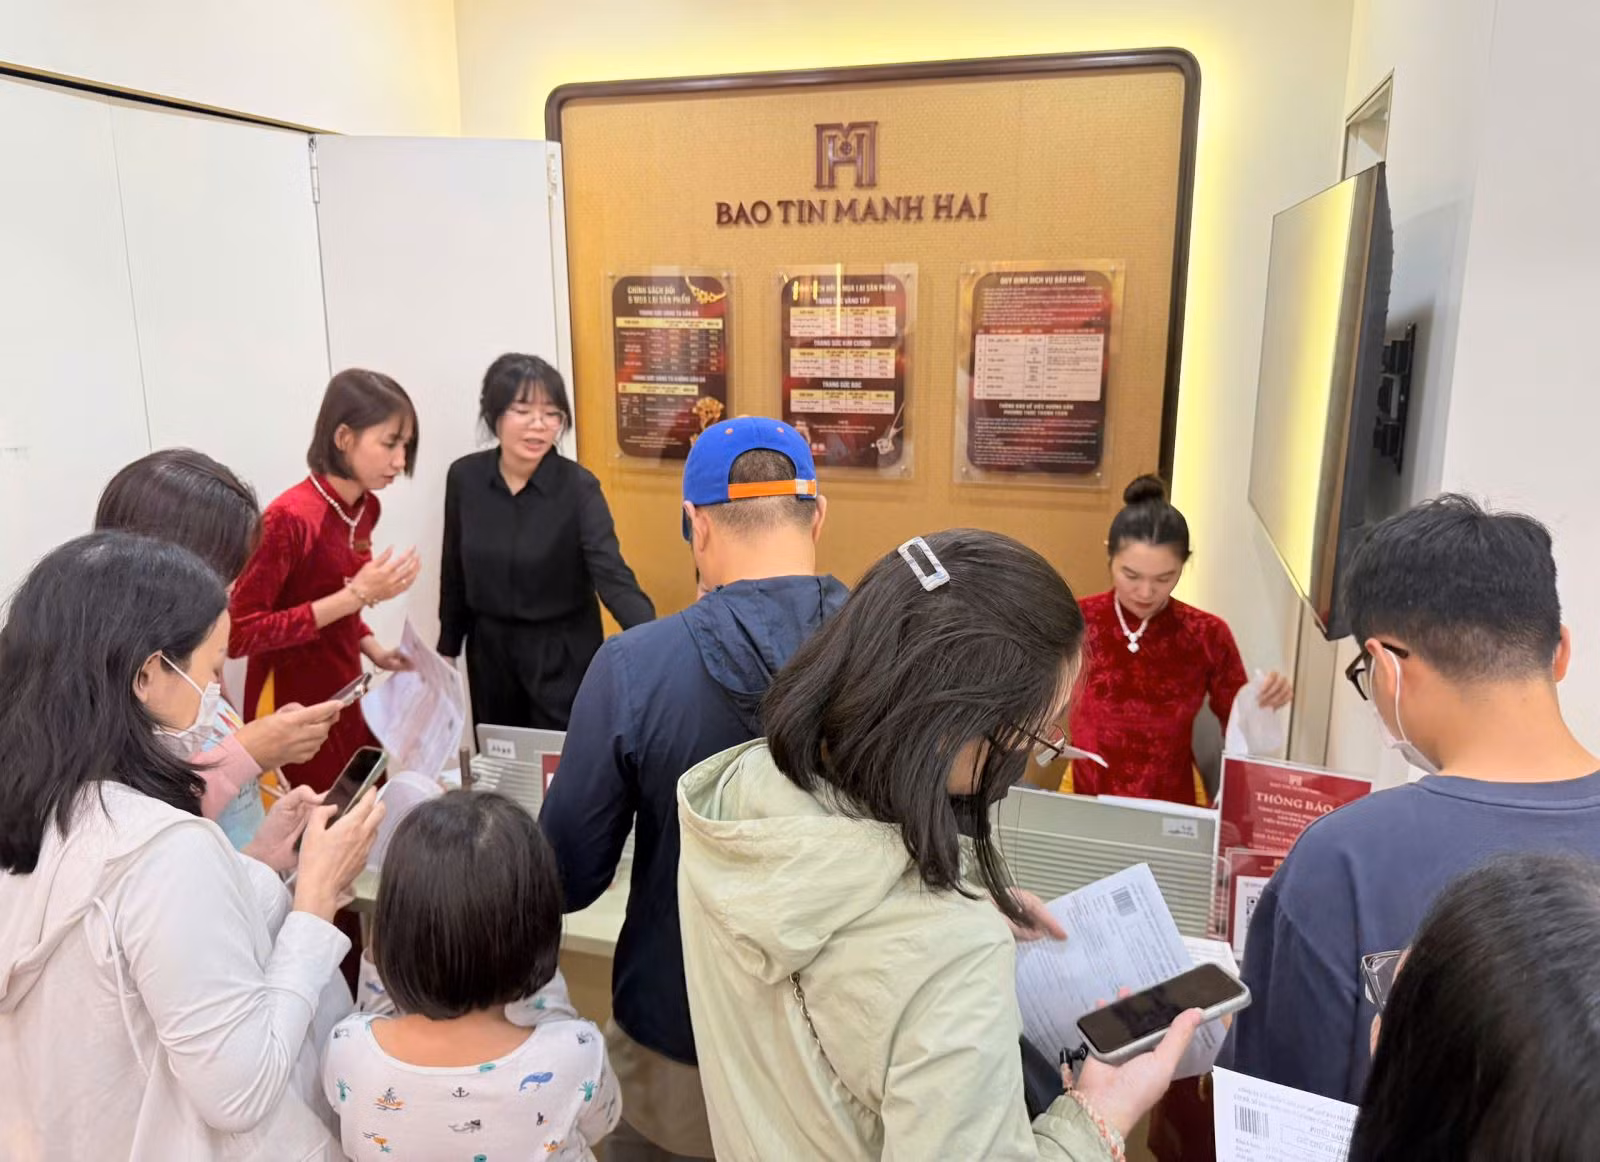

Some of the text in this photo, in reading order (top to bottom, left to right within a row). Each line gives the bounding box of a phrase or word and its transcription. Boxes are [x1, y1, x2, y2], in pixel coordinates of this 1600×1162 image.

[715, 192, 989, 226] BAO TIN MANH HAI
[1255, 791, 1303, 809] THÔNG
[1305, 800, 1334, 814] BÁO
